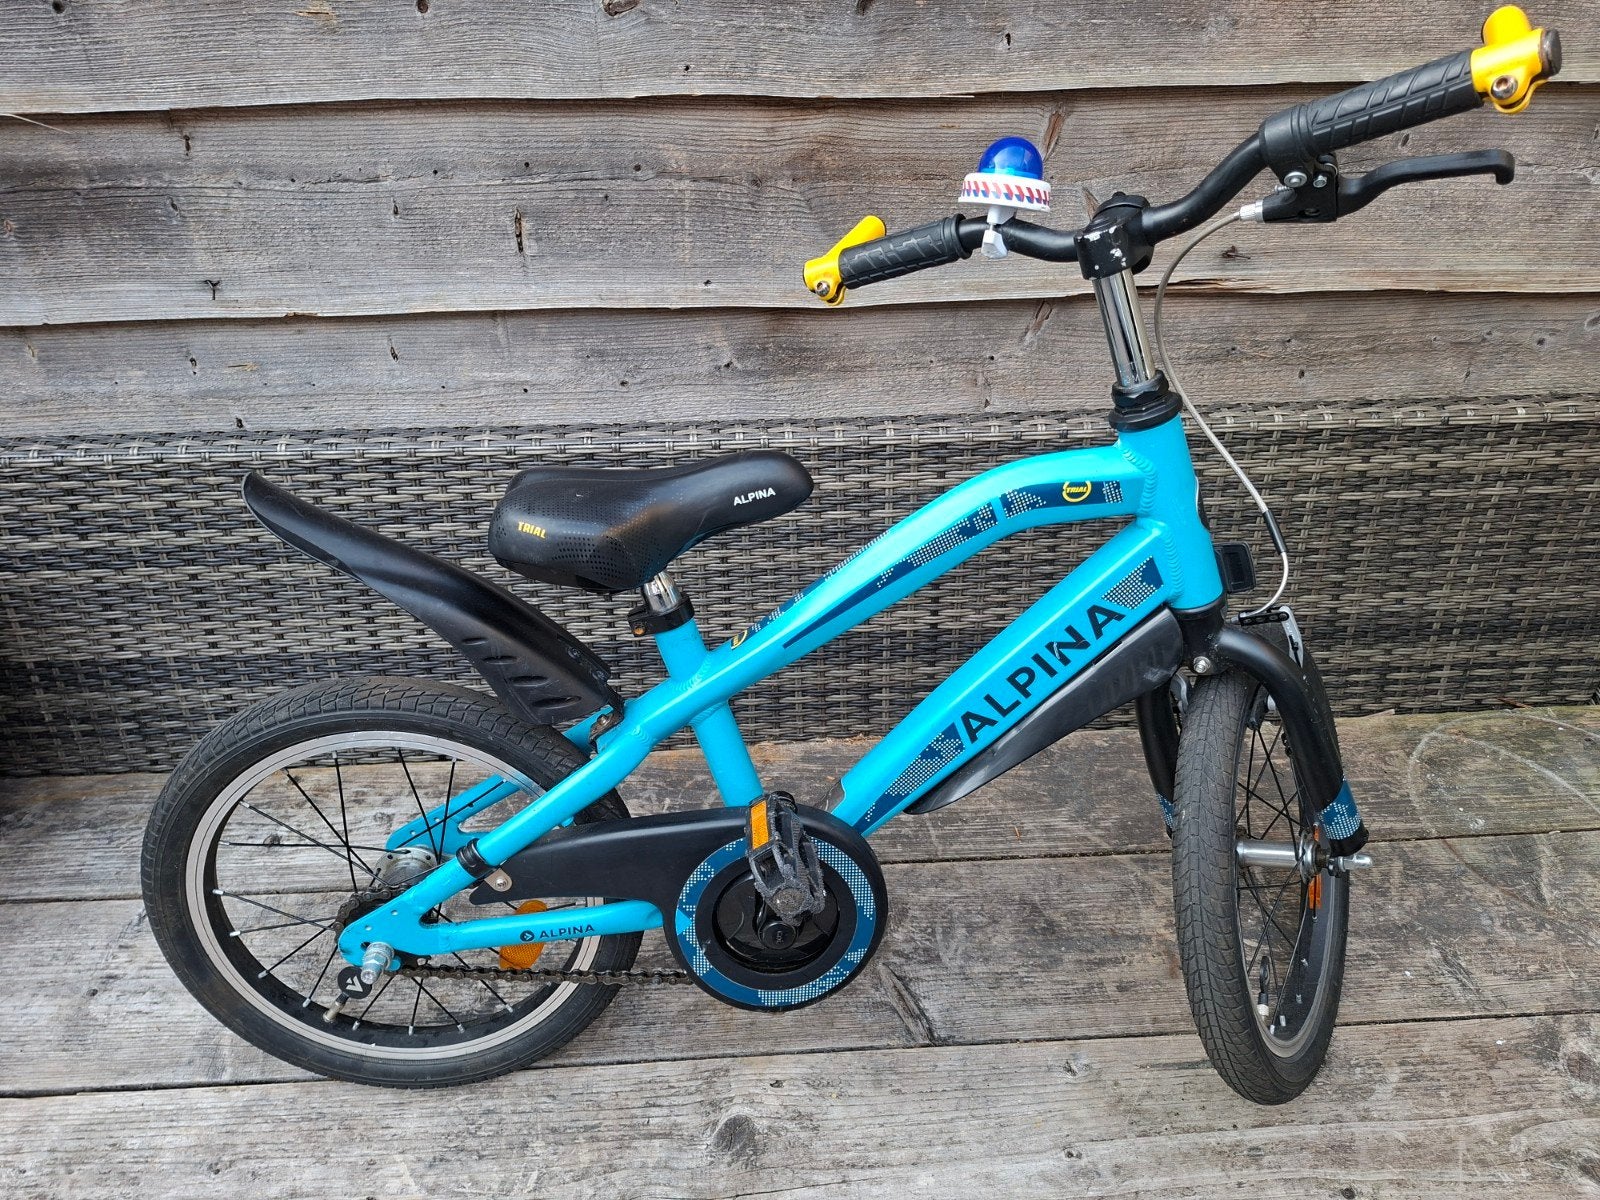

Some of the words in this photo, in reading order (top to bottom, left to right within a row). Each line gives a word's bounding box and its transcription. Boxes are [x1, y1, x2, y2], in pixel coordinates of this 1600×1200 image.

[733, 487, 776, 506] ALPINA
[518, 521, 546, 539] TRIAL
[960, 604, 1126, 744] ALPINA
[540, 924, 595, 939] ALPINA
